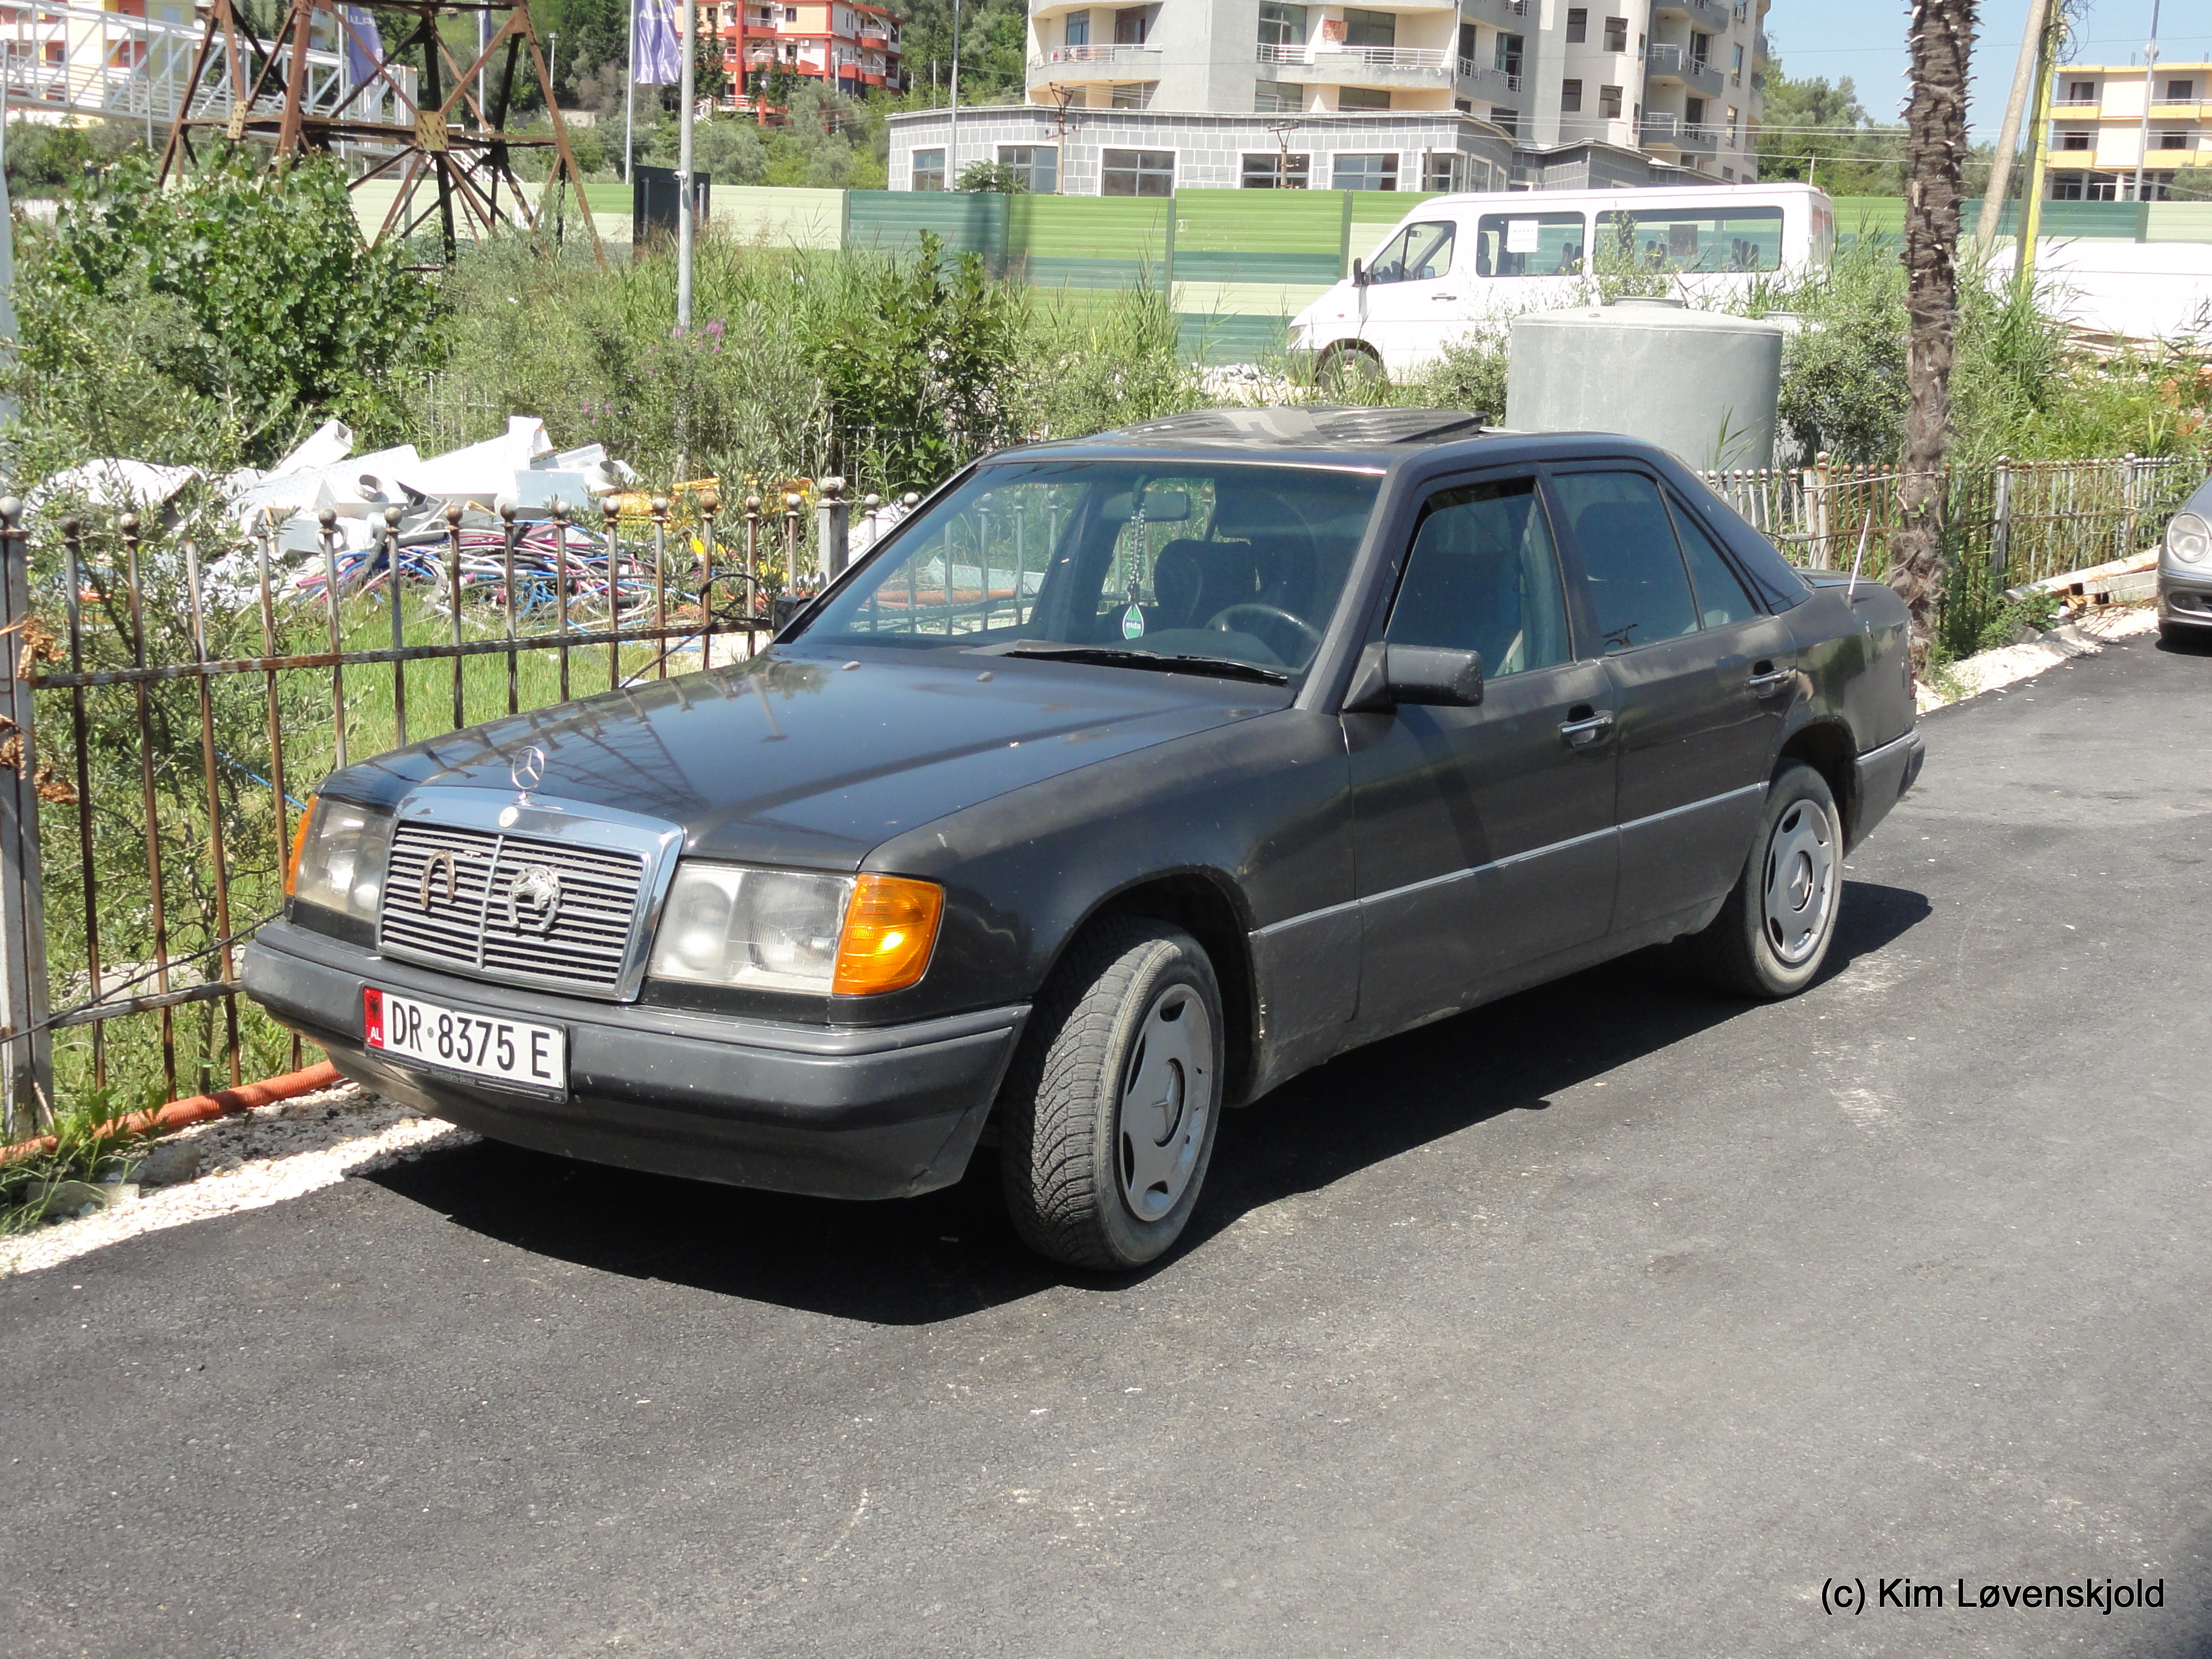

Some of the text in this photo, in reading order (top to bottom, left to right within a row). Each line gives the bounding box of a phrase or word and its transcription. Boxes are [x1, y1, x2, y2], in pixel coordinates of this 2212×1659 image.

[370, 1026, 382, 1041] AL
[392, 1000, 551, 1079] DR 8375 E
